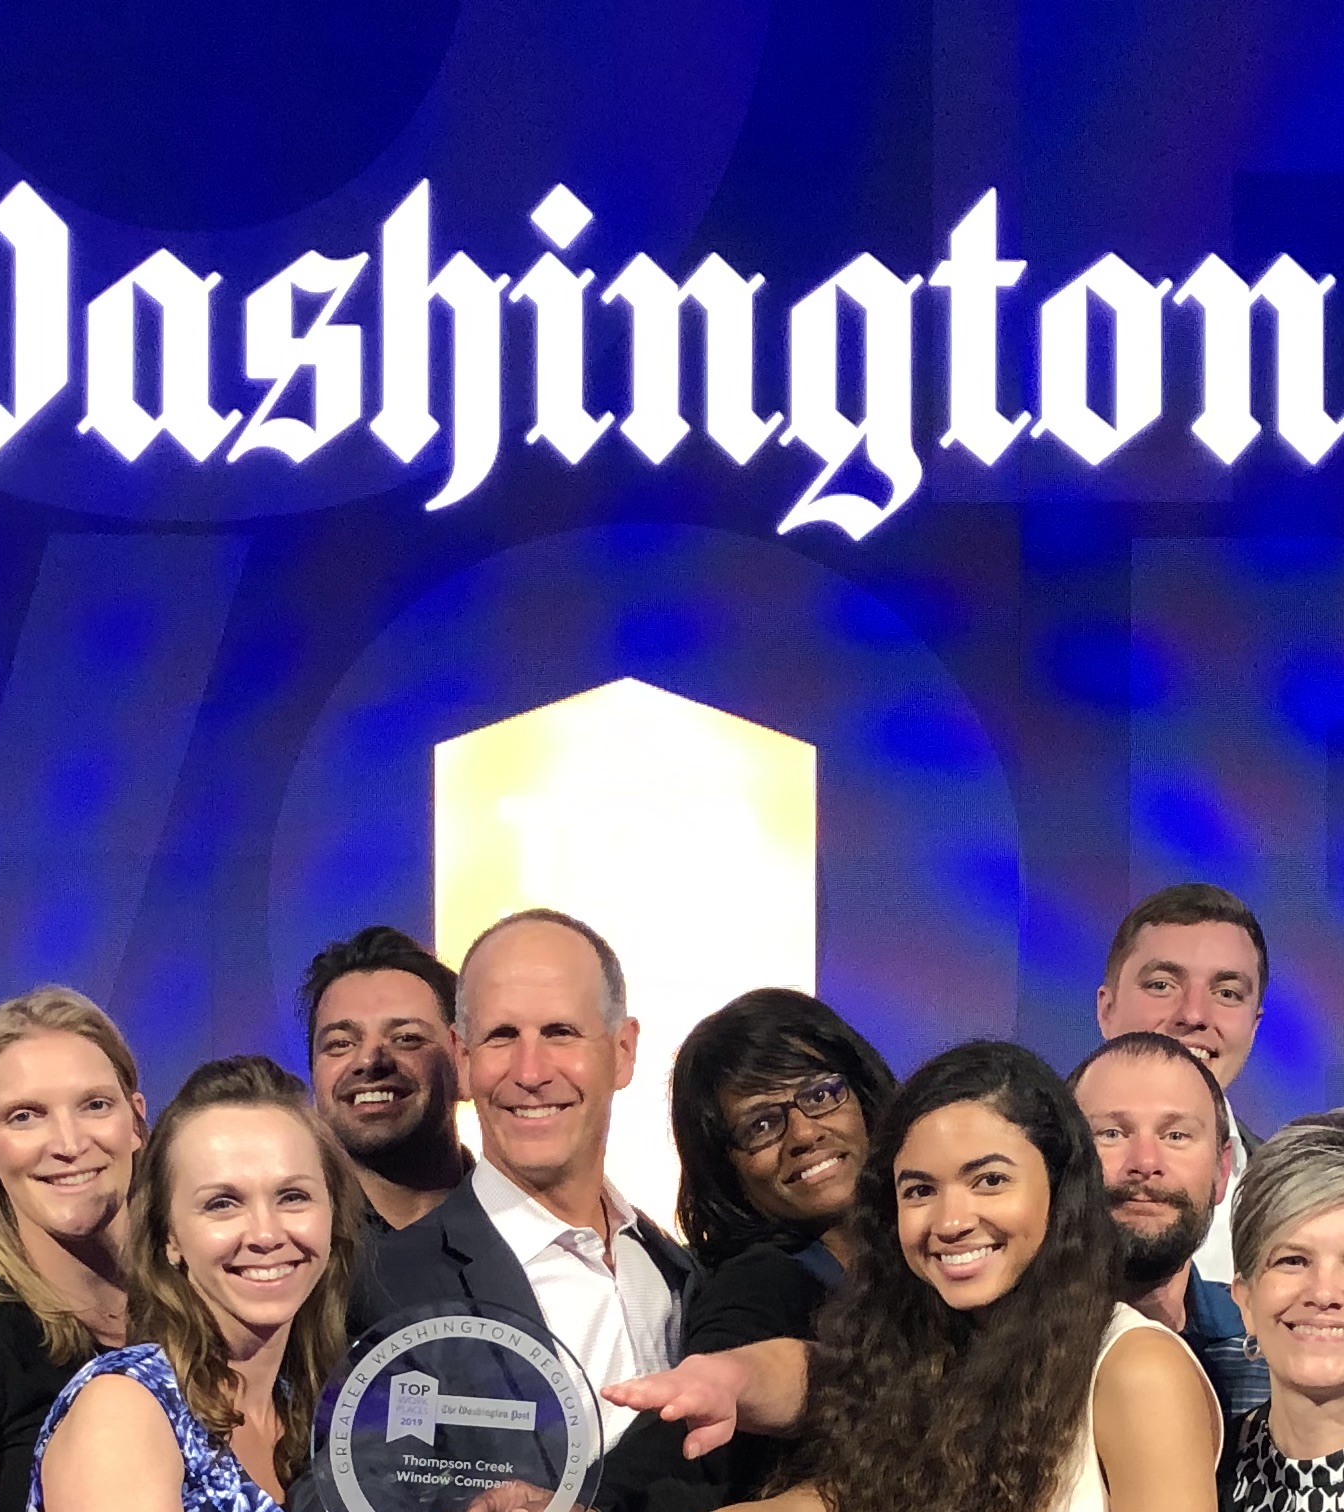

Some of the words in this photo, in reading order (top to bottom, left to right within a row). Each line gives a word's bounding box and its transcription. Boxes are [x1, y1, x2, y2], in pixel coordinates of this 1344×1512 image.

[398, 1383, 431, 1396] TOP
[336, 1372, 369, 1474] GREATER
[372, 1321, 522, 1365] WASHINGTON
[529, 1347, 580, 1427] REGION
[563, 1441, 581, 1491] 2019
[400, 1417, 423, 1426] 2019
[511, 1409, 530, 1421] Post
[402, 1454, 472, 1470] Thompson
[475, 1460, 514, 1474] Creek
[396, 1471, 450, 1485] Window
[454, 1475, 516, 1490] Company
